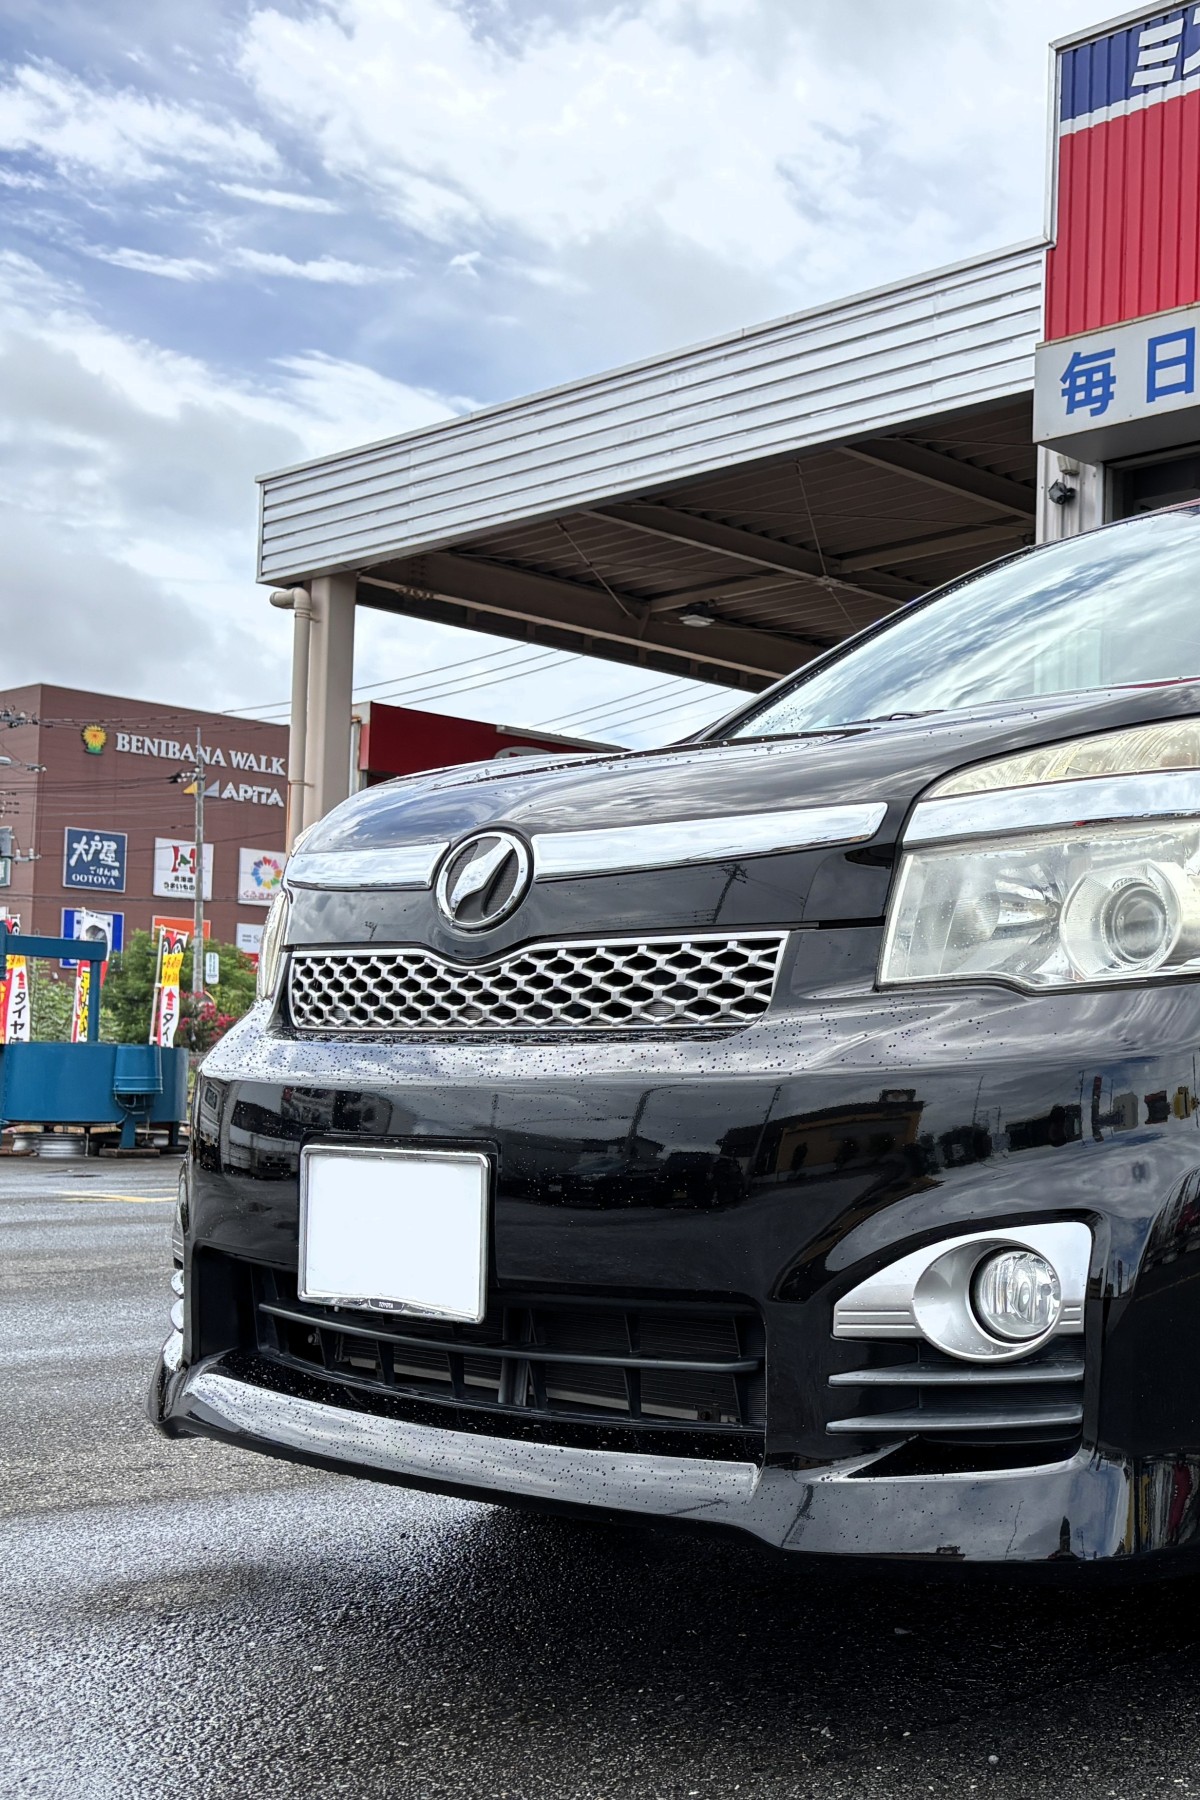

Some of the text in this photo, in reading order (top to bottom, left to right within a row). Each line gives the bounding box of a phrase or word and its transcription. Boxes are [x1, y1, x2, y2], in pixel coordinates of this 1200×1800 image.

[115, 732, 286, 776] BENIBANA WALK
[69, 834, 120, 867] 大戸屋
[71, 873, 116, 886] OOTOYA
[162, 1012, 175, 1047] タイ
